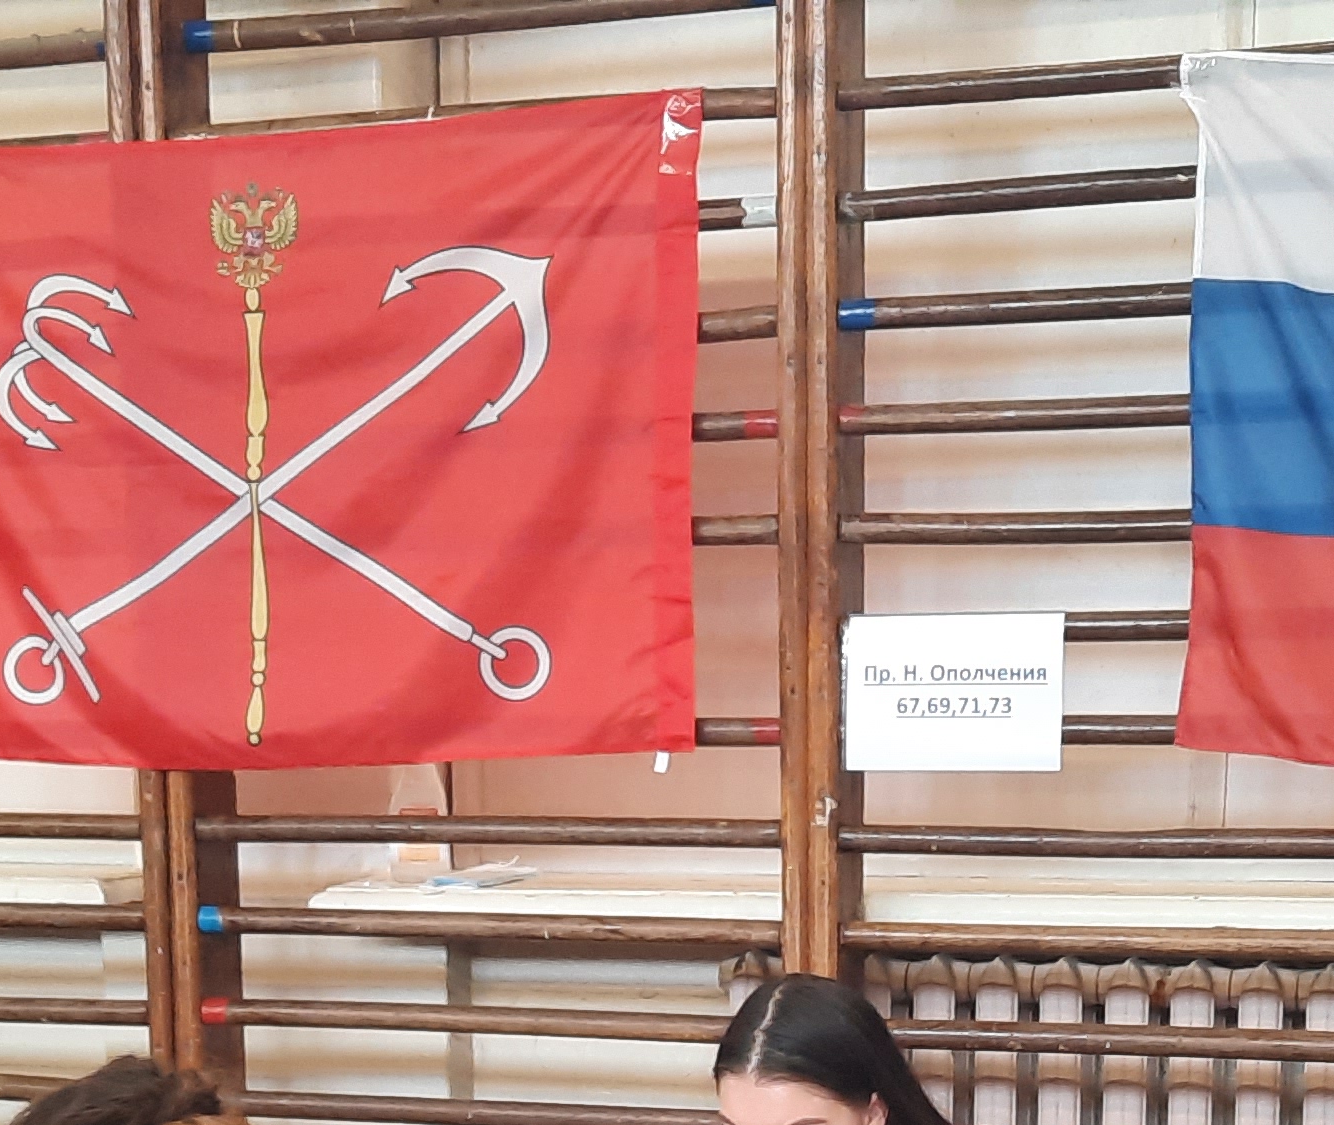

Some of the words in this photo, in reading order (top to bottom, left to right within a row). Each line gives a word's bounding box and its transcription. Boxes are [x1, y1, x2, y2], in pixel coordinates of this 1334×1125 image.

[864, 665, 896, 684] Пр.
[904, 664, 923, 682] Н.
[930, 664, 1048, 682] Ополчения
[896, 697, 1012, 717] 67,69,71,73
